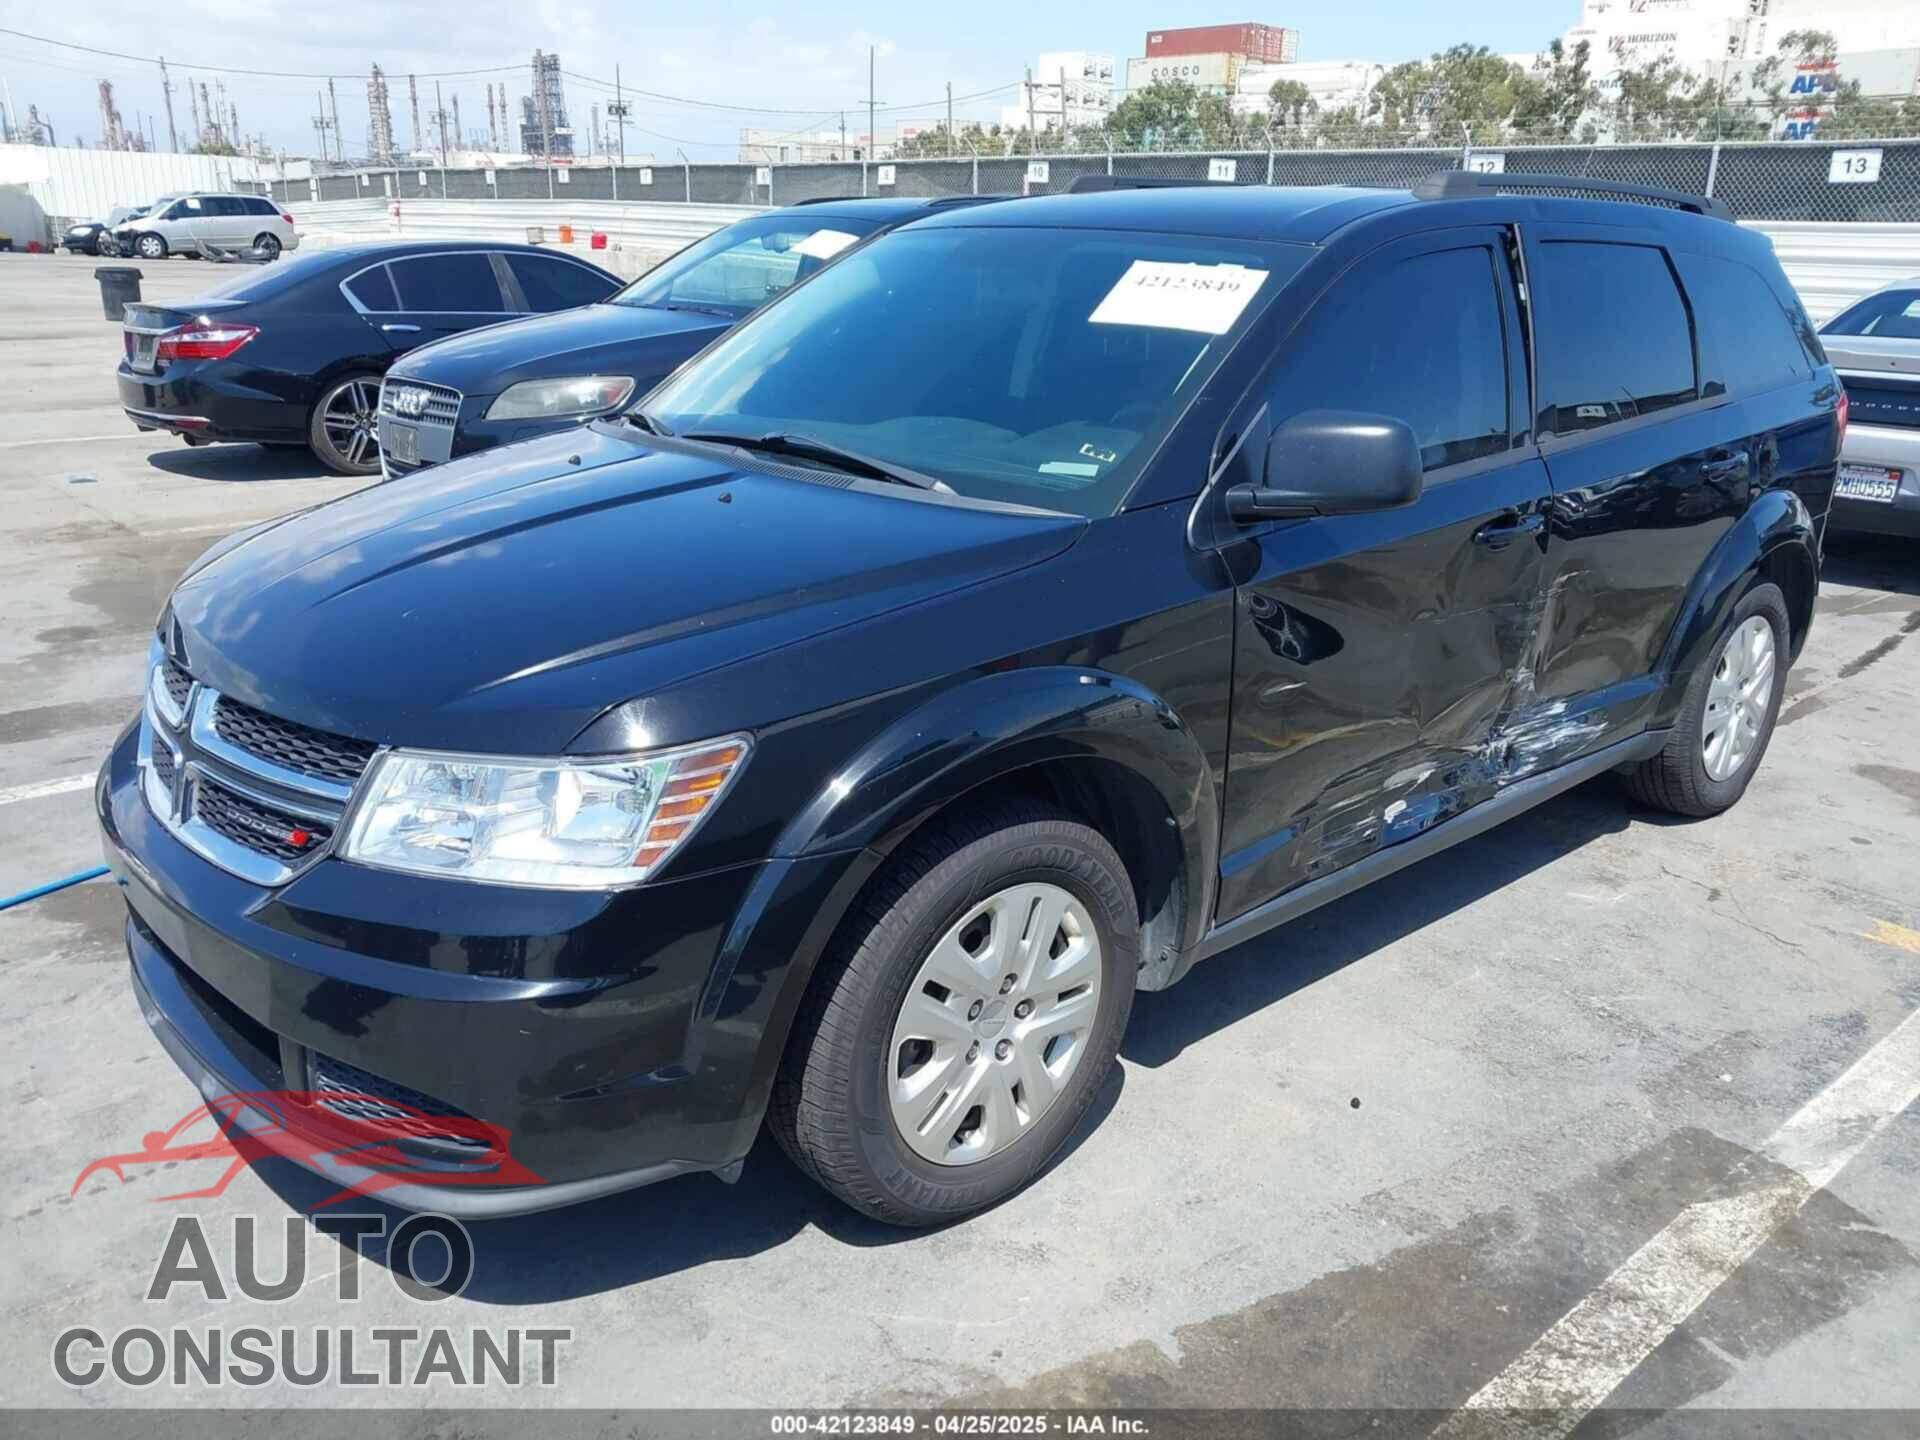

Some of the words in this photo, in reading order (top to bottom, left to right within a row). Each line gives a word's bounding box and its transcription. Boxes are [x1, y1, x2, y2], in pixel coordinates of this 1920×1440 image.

[1627, 32, 1678, 43] HORIZON
[1151, 64, 1200, 78] COSCO
[1032, 165, 1044, 177] 10
[1217, 164, 1229, 177] 11
[1479, 161, 1496, 175] 12
[1843, 157, 1867, 174] 13
